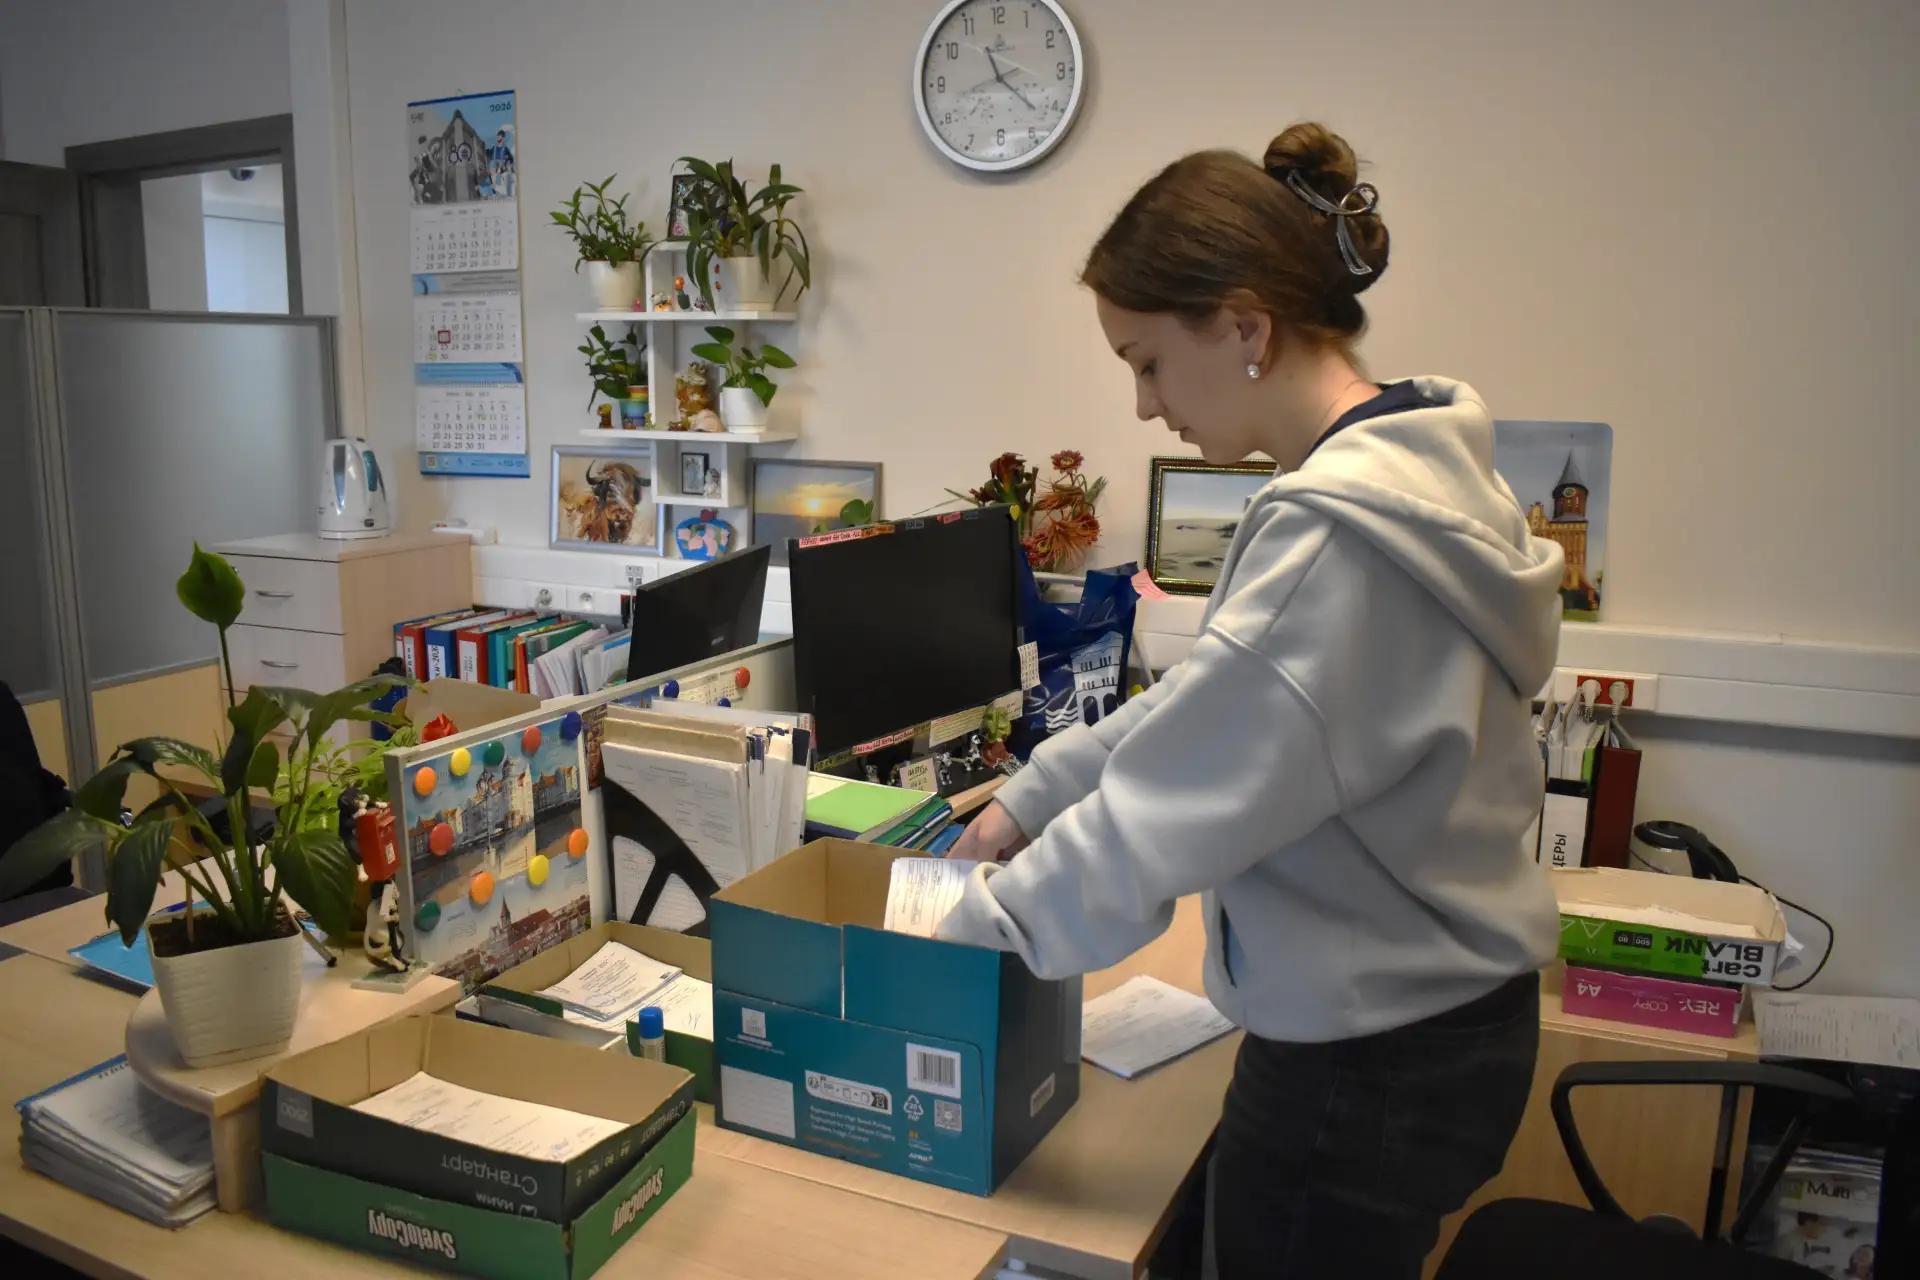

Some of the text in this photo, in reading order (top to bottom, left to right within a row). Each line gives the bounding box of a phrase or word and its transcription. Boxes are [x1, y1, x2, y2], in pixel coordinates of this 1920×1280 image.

[992, 6, 1006, 25] 12
[1023, 10, 1029, 28] 1
[963, 18, 974, 36] 11
[1046, 30, 1055, 49] 2
[946, 42, 958, 60] 10
[1056, 62, 1066, 80] 3
[938, 76, 946, 94] 9
[944, 112, 952, 124] 8
[968, 134, 974, 146] 7
[996, 128, 1006, 146] 6
[1028, 127, 1036, 139] 5
[1664, 934, 1764, 963] BLANK
[1701, 959, 1762, 978] cart
[1576, 982, 1602, 997] A4
[1632, 997, 1720, 1016] REY COPY
[440, 1153, 538, 1196] Стандарт
[611, 1167, 664, 1236] SvetoCopy
[368, 1209, 457, 1260] SvetoCopy
